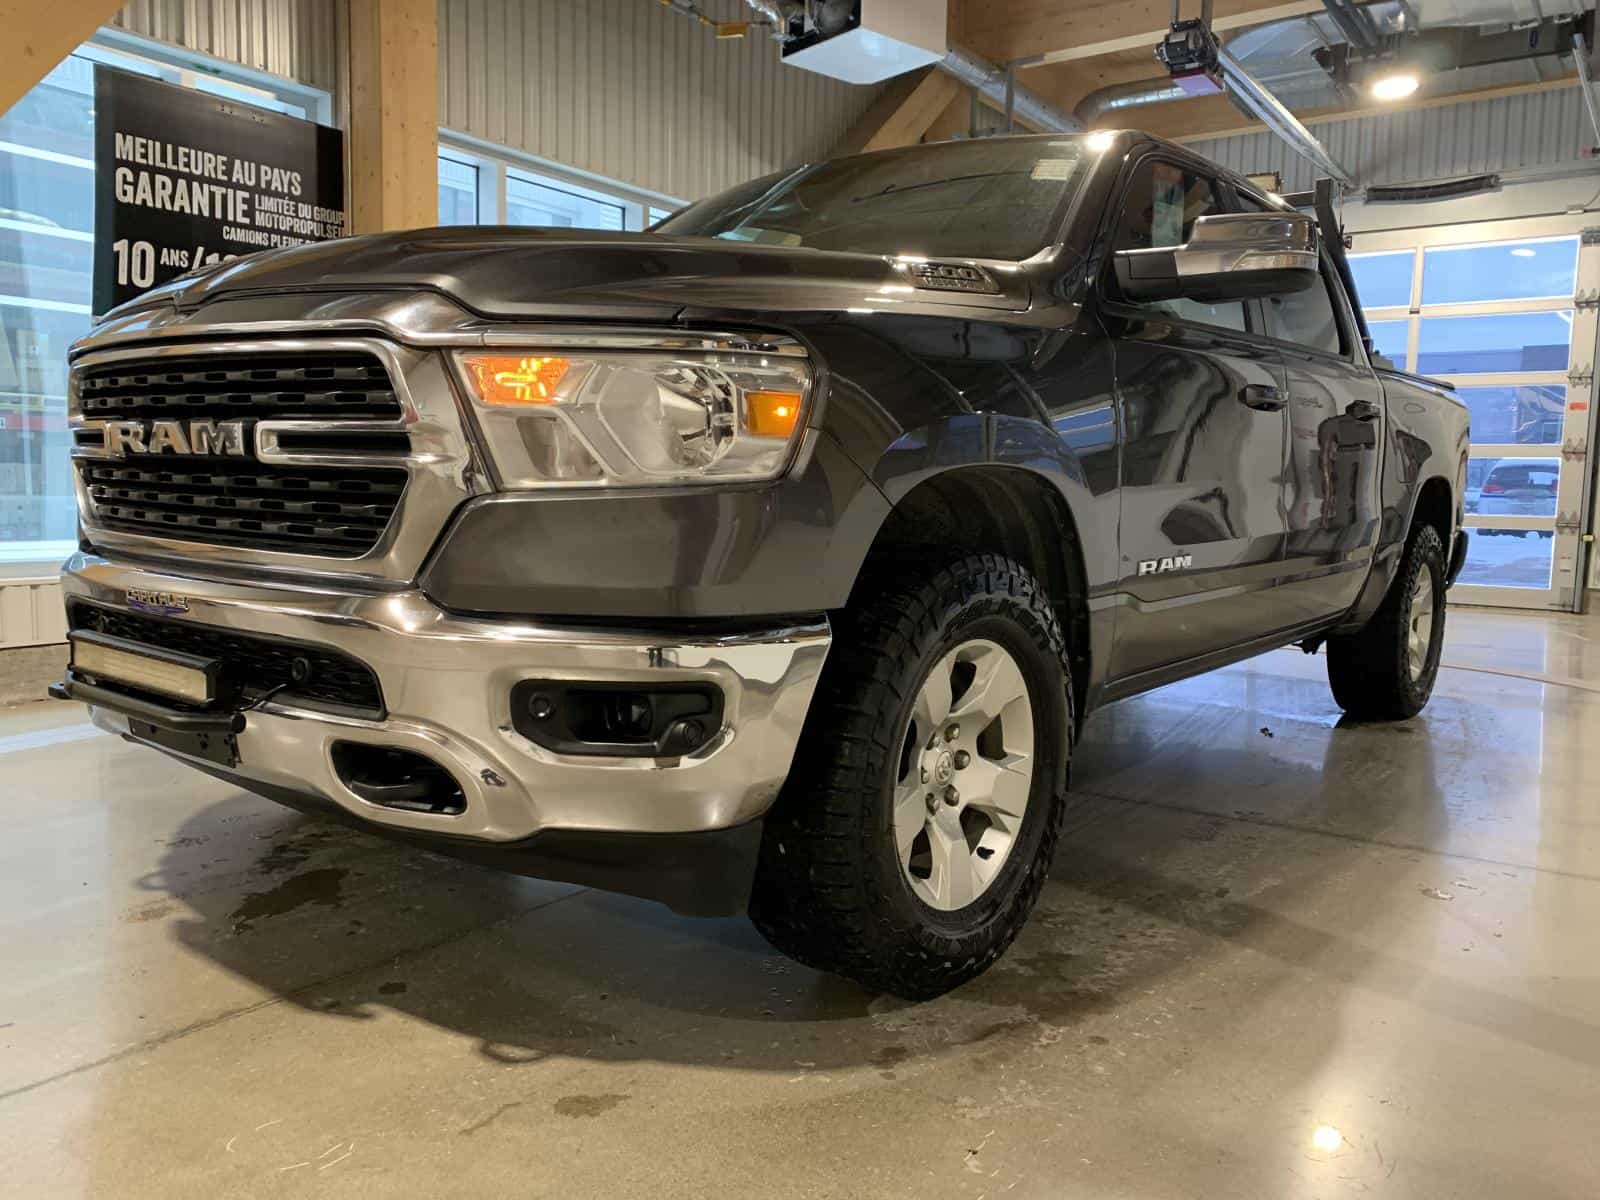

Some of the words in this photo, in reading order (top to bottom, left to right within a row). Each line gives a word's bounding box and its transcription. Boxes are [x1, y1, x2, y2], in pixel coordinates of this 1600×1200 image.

[115, 132, 228, 181] MEILLEURE
[232, 159, 256, 187] AU
[260, 164, 302, 196] PAYS
[115, 166, 250, 225] GARANTIE
[255, 193, 296, 217] LIMITÉE
[298, 202, 312, 220] DU
[223, 225, 270, 248] CAMIONS
[112, 238, 156, 288] 10
[160, 247, 189, 268] ANS
[106, 420, 245, 457] RAM
[1138, 555, 1193, 577] RAM
